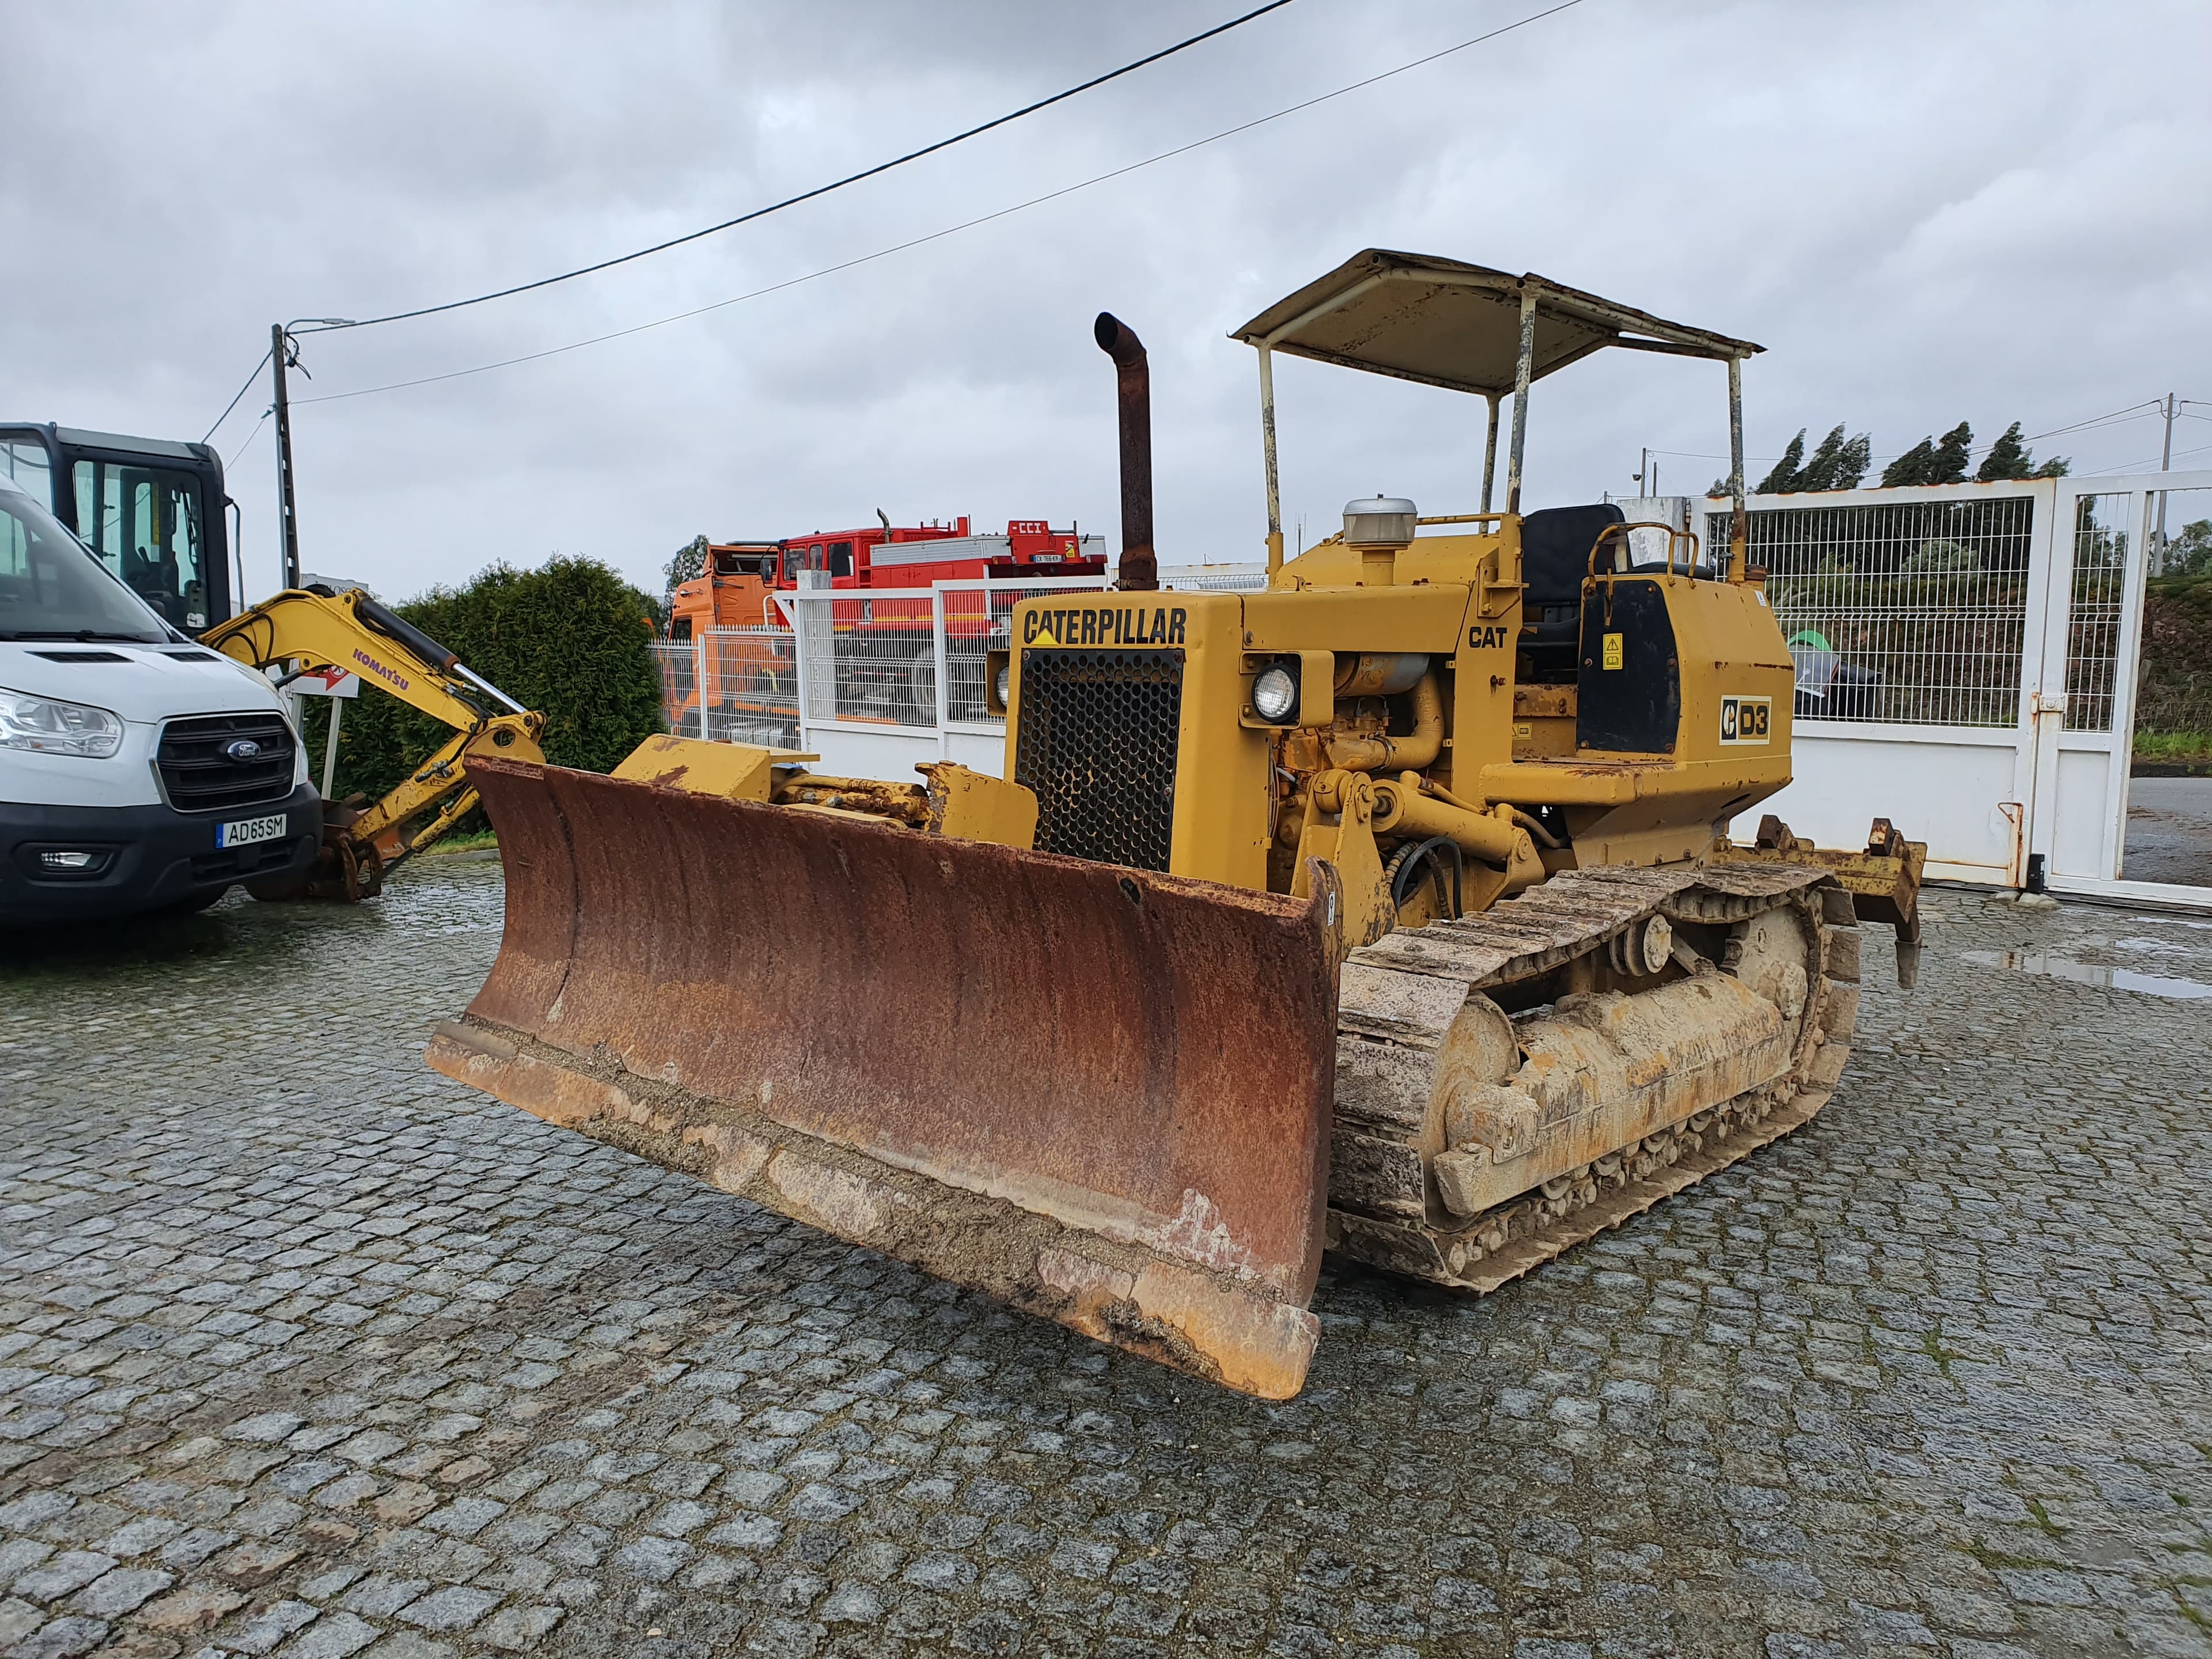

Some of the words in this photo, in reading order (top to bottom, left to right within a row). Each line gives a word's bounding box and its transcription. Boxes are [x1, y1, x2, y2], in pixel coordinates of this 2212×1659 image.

[1024, 608, 1187, 644] CATERPILLAR
[1469, 626, 1508, 649] CAT
[353, 647, 410, 691] KOMATSU
[1740, 705, 1768, 735] D3
[238, 744, 256, 757] Ford
